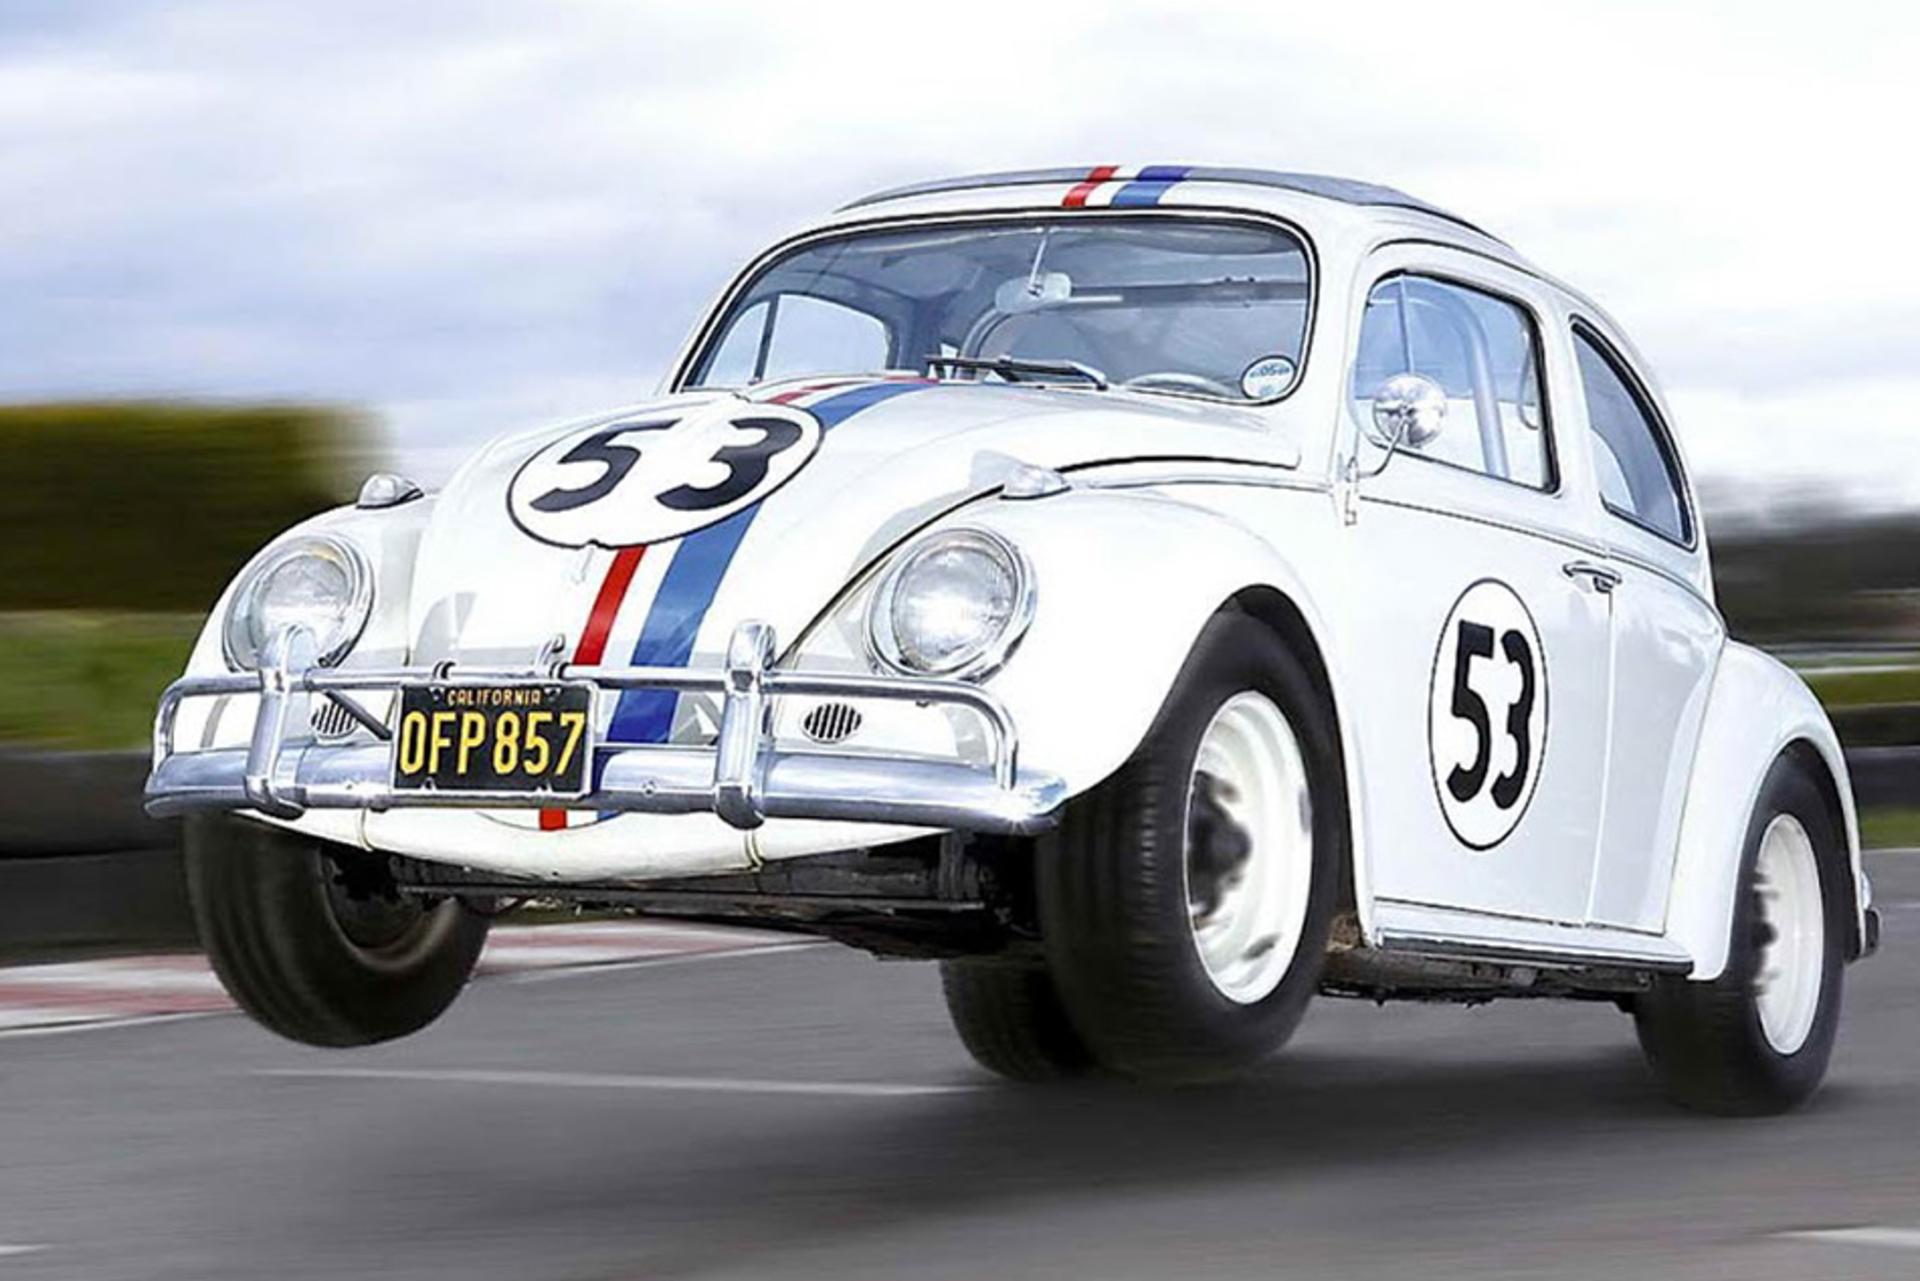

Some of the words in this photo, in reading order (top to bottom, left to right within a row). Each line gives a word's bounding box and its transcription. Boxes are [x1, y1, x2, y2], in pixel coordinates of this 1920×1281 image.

[528, 416, 804, 513] 53
[447, 688, 542, 706] CALIFORNIA
[1446, 618, 1535, 810] 53
[493, 711, 586, 775] 857
